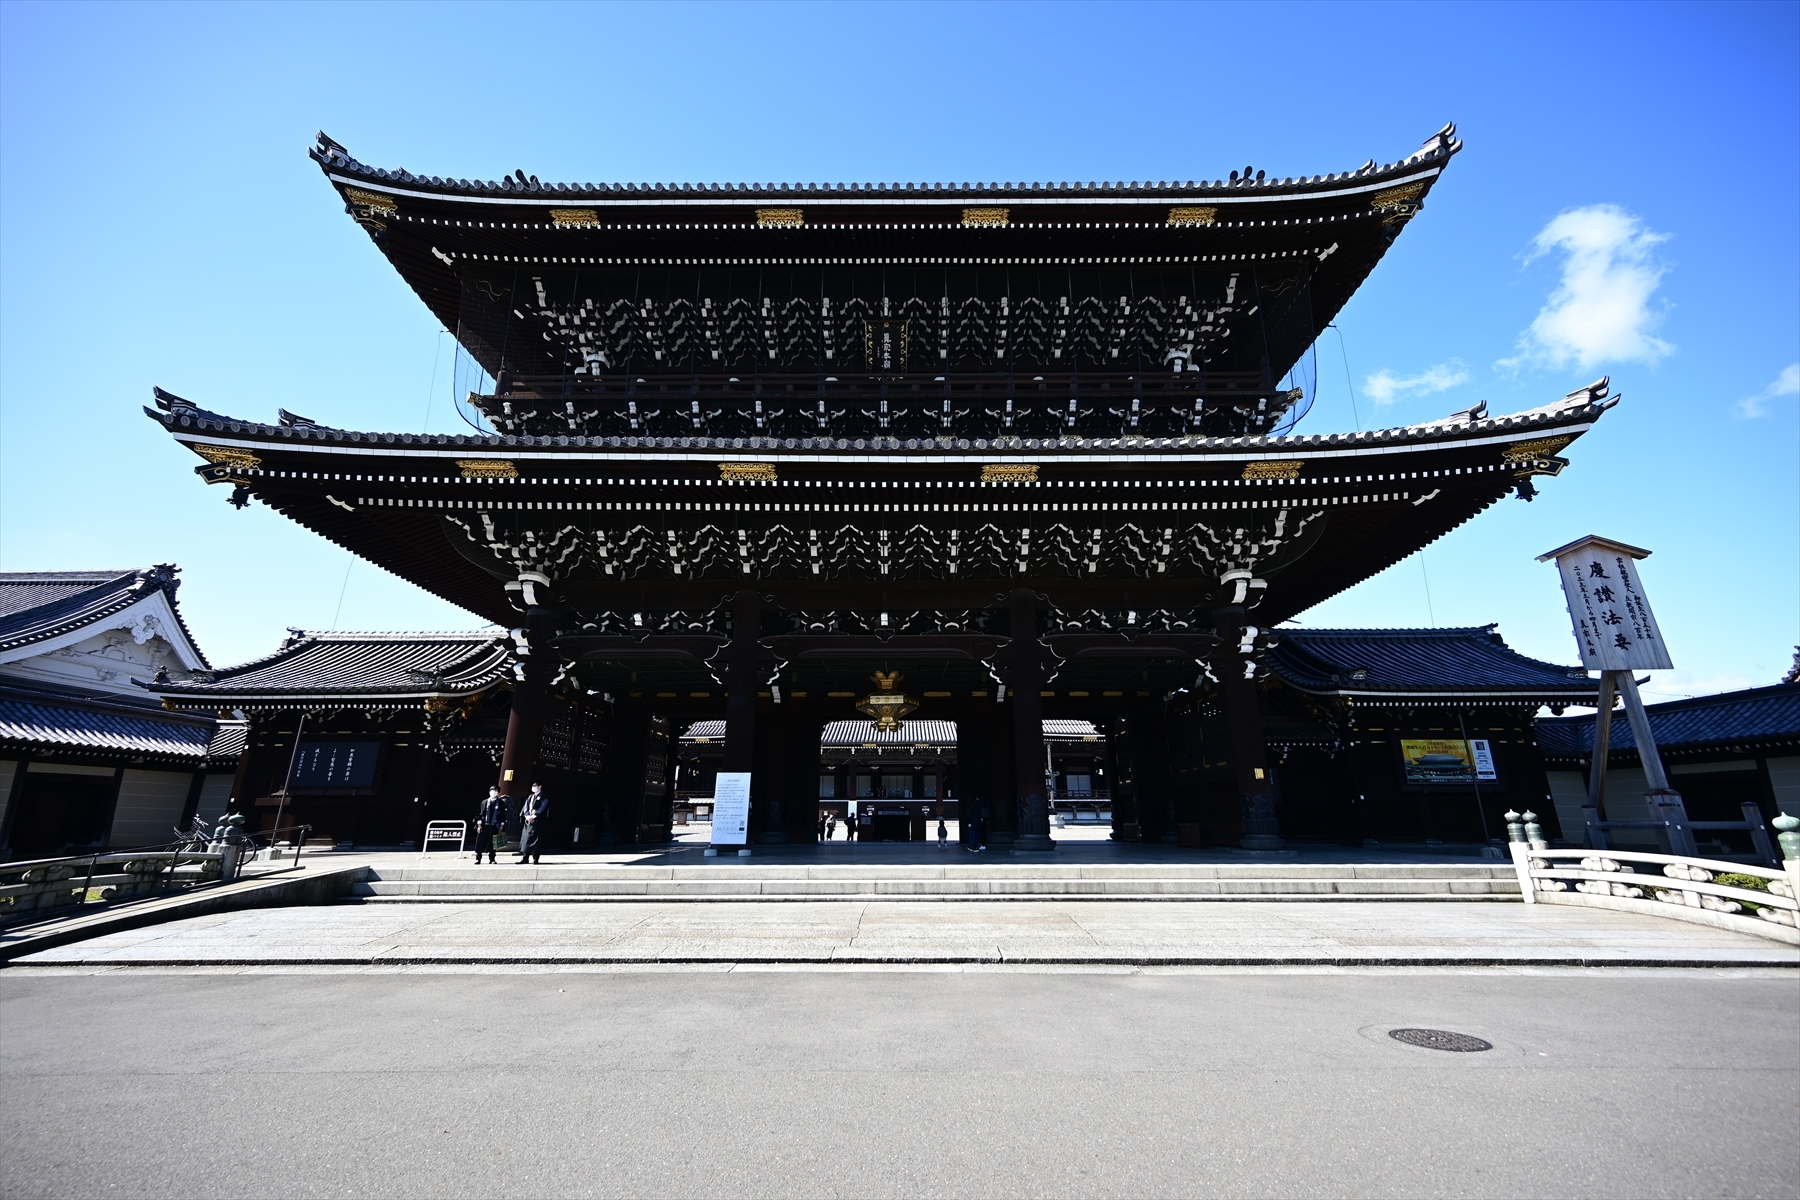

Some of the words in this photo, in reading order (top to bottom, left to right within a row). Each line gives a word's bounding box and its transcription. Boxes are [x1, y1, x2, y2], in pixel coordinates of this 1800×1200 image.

[1633, 594, 1655, 640] 御誕生八百五十年
